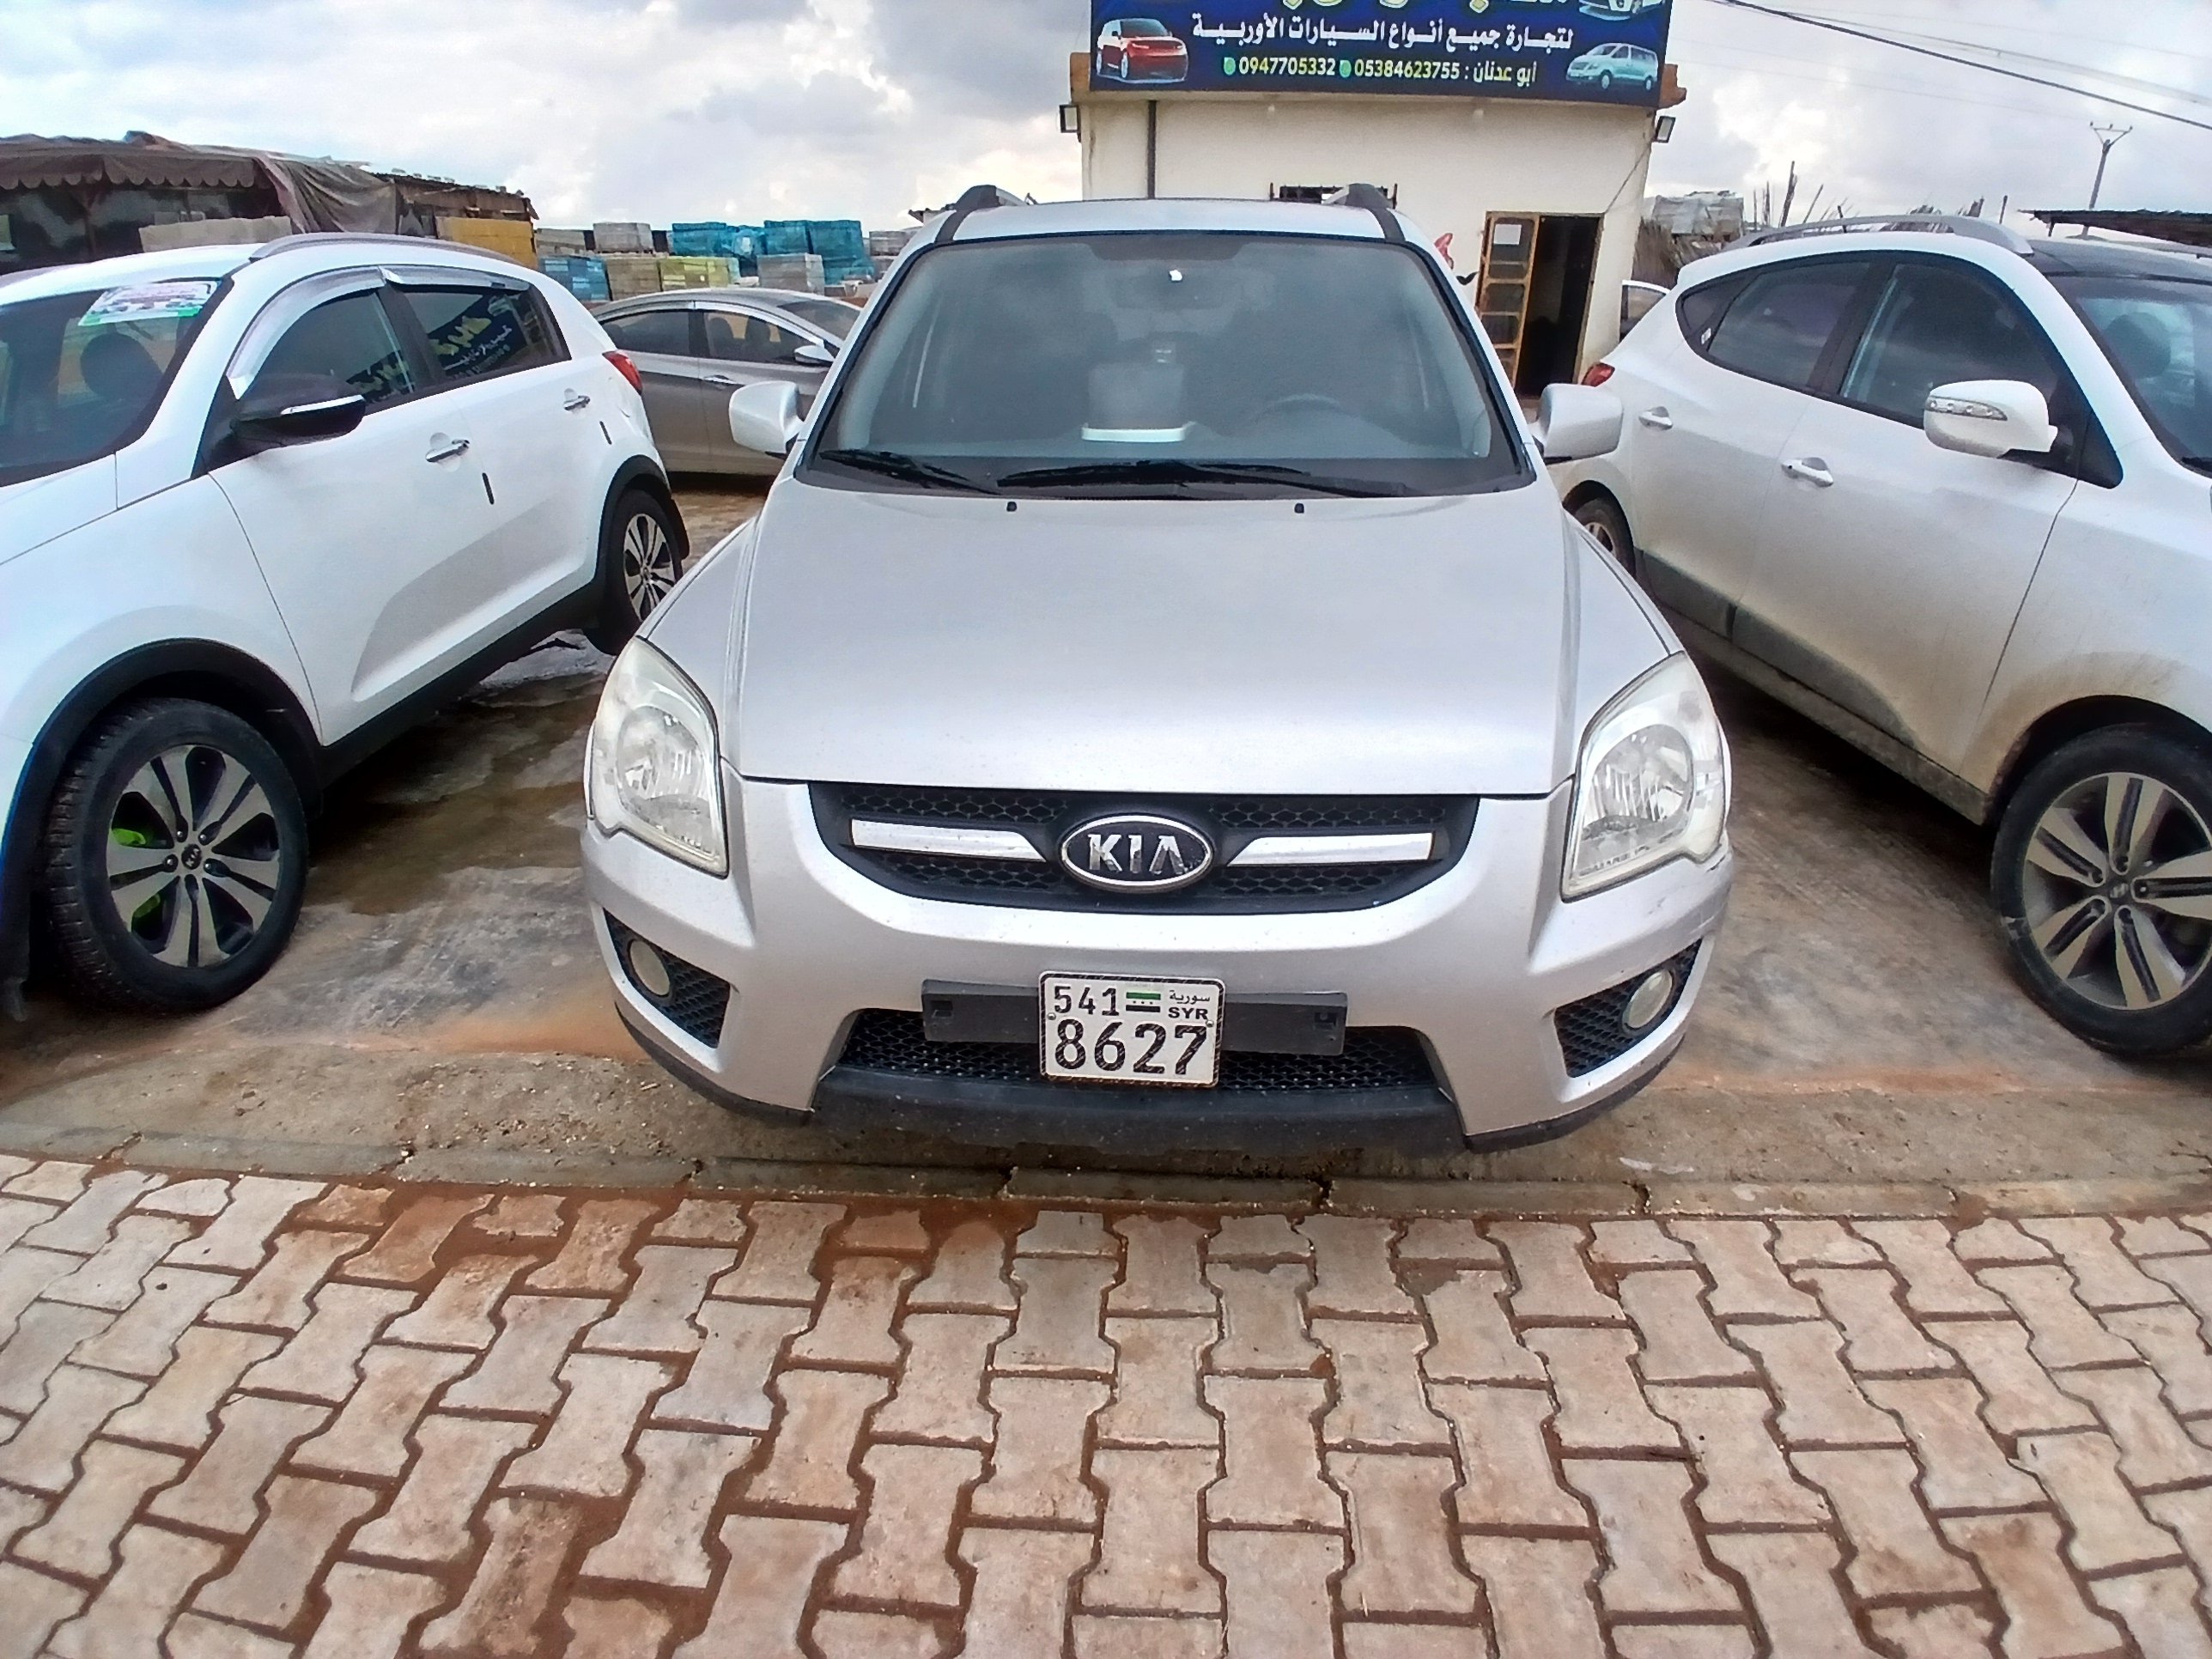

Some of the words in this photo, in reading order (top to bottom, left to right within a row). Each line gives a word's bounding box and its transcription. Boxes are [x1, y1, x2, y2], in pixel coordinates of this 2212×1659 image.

[1192, 12, 1285, 46] الأوربية
[1288, 15, 1385, 46] السيارات
[1388, 18, 1443, 49] أنواع
[1445, 27, 1501, 52] جميع
[1505, 23, 1574, 54] لتجارة
[1239, 57, 1336, 76] 0947705332
[1354, 59, 1460, 79] 05384623755
[1473, 60, 1512, 82] عدنان
[1087, 834, 1186, 875] KIA
[1054, 986, 1120, 1017] 541
[1168, 1006, 1209, 1020] SYR
[1169, 990, 1211, 1006] سورية
[1054, 1018, 1207, 1075] 8627
